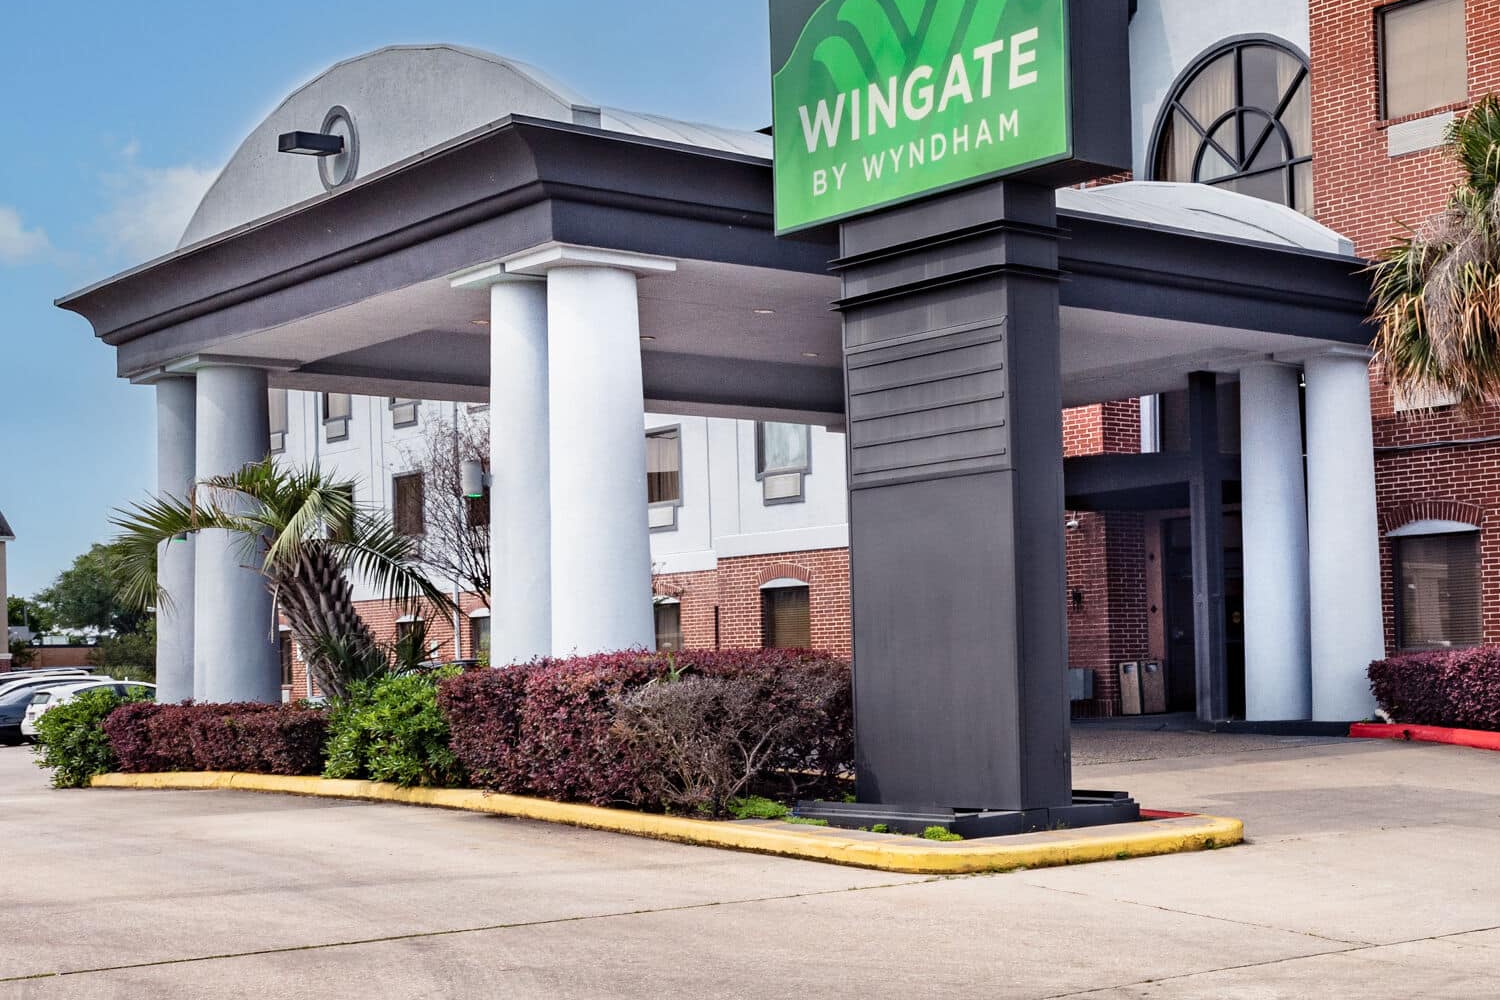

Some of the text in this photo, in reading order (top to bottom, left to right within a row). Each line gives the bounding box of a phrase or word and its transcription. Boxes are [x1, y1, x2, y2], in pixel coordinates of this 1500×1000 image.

[798, 27, 1039, 153] WINGATE
[813, 110, 1020, 198] BY WYNDHAM
